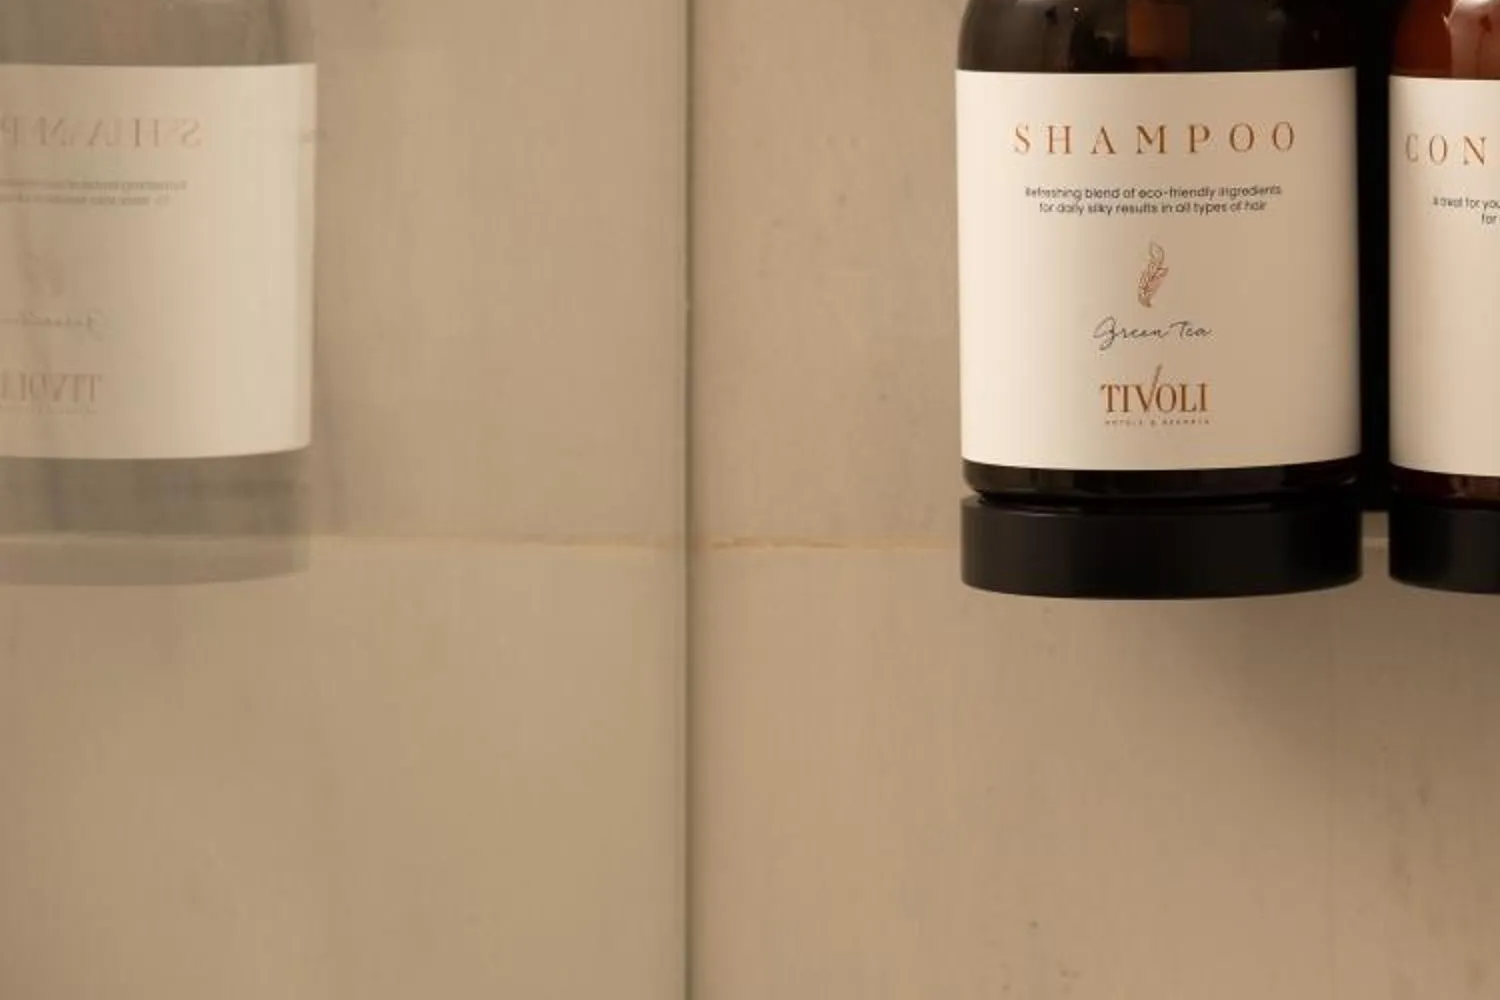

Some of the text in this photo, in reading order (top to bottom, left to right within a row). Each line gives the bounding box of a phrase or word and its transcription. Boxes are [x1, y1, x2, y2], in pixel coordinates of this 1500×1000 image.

[1013, 121, 1296, 155] SHAMPOO
[1085, 187, 1121, 199] blend
[1122, 187, 1136, 199] of
[1138, 186, 1217, 200] eco-friendly
[1218, 185, 1282, 200] ingredients
[1039, 203, 1056, 214] for
[1057, 203, 1085, 216] daily
[1115, 203, 1160, 213] results
[1161, 203, 1174, 213] in
[1175, 202, 1192, 213] all
[1193, 202, 1228, 216] types
[1229, 201, 1243, 213] of
[1244, 200, 1267, 211] hair
[1465, 198, 1481, 209] for
[1481, 214, 1499, 225] for
[1093, 316, 1214, 351] Green Tea
[1100, 363, 1208, 413] TIVOLI
